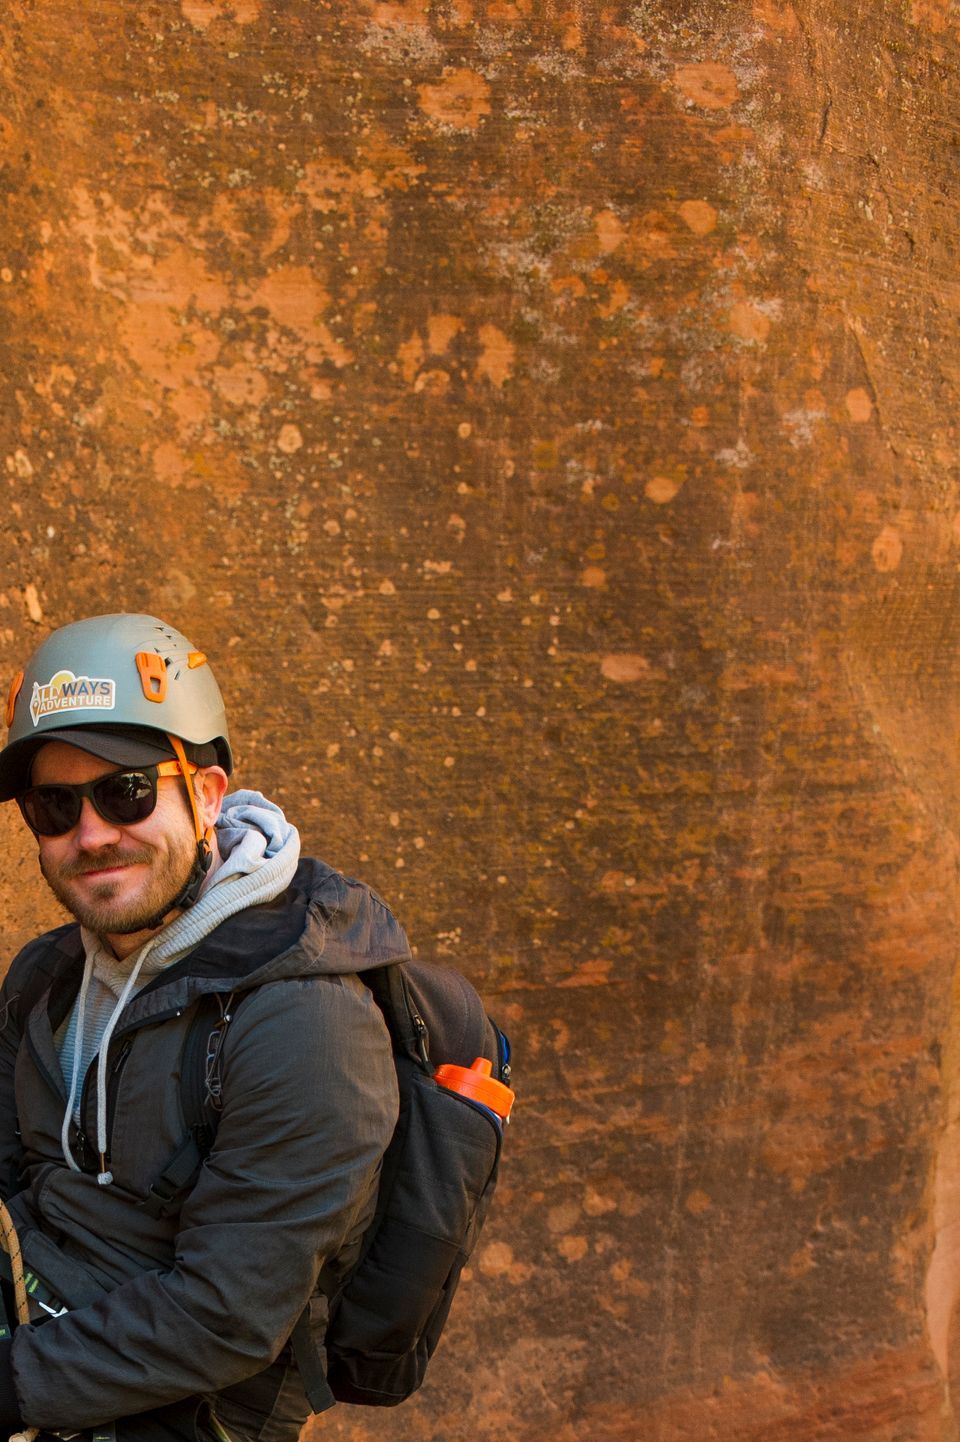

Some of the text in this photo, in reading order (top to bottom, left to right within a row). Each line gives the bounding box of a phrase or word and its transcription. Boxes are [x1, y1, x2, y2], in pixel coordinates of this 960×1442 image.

[31, 681, 111, 702] ALL WAYS
[40, 695, 111, 713] ADVENTURE
